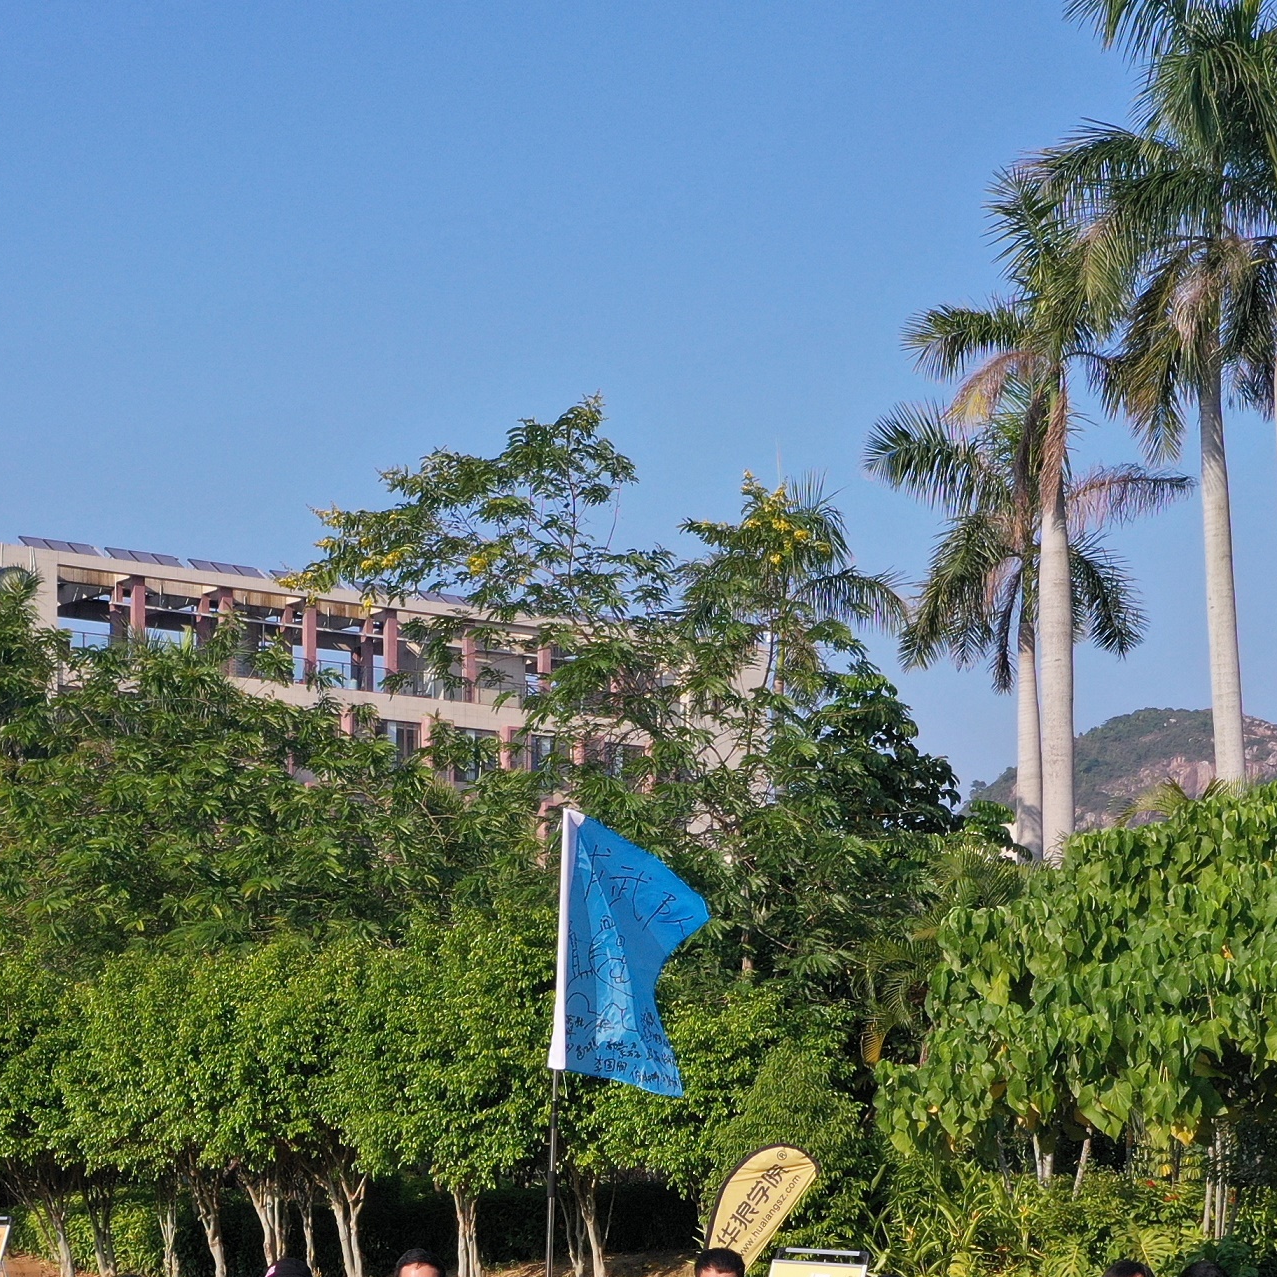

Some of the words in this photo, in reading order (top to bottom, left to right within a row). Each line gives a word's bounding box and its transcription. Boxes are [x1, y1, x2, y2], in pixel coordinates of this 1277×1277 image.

[717, 1163, 790, 1248] 华狼学院
[739, 1174, 801, 1257] ww.hualangsz.com
